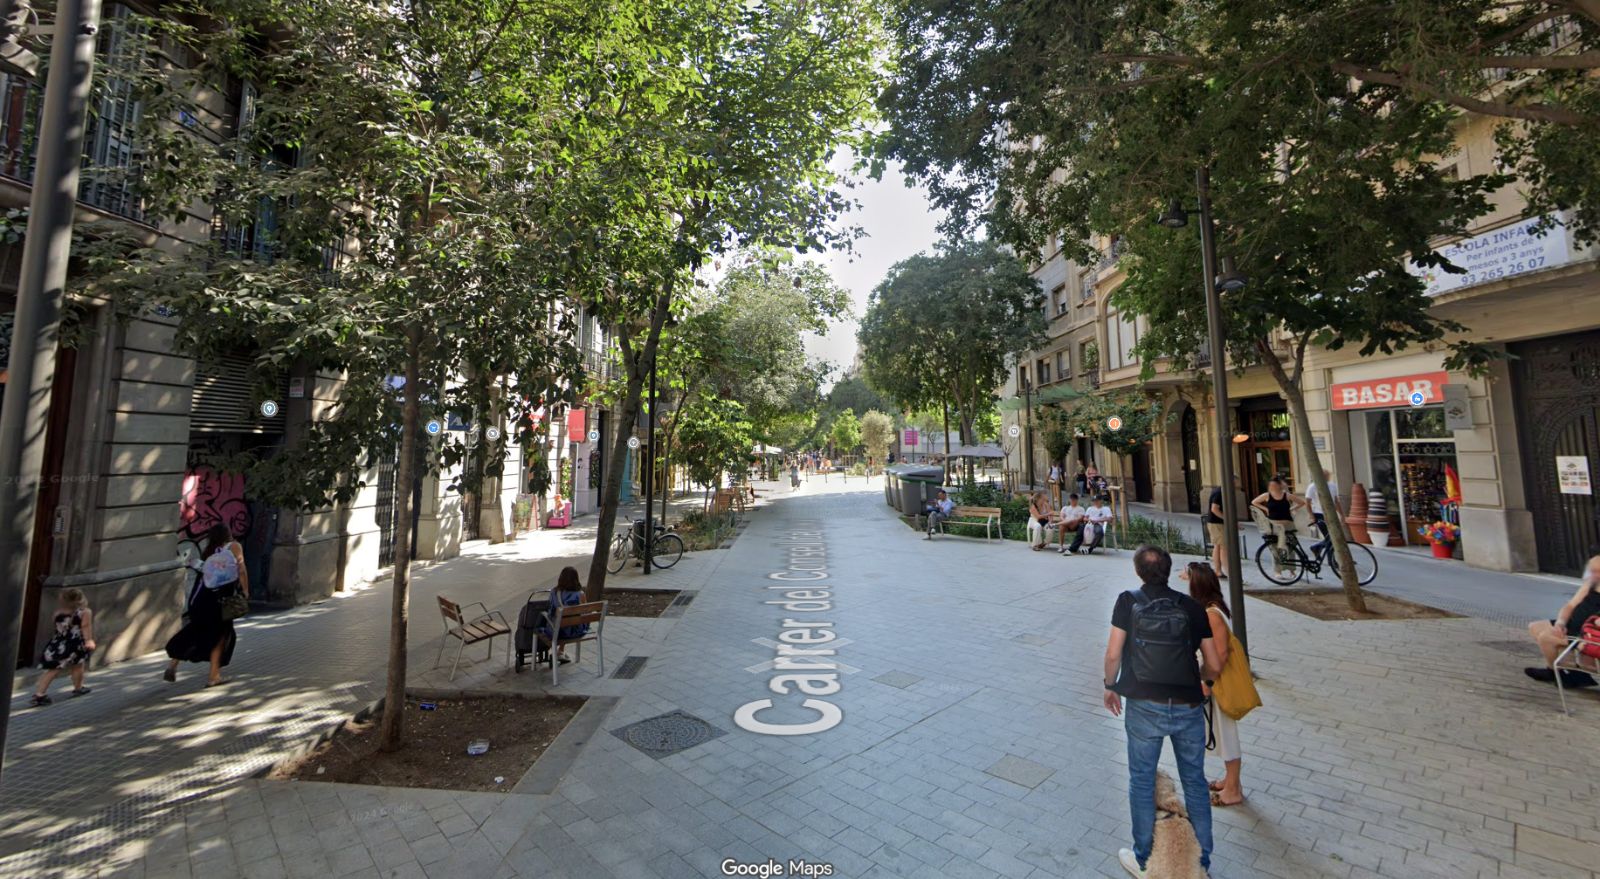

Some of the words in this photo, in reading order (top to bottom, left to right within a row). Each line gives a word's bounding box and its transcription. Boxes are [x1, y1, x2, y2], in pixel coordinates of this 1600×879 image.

[1445, 238, 1489, 257] ESCOLA
[1467, 252, 1481, 261] Per
[1484, 242, 1518, 257] infants
[1521, 237, 1534, 246] de
[1469, 259, 1499, 271] mesos
[1511, 252, 1517, 260] 3
[1520, 245, 1544, 258] anys
[1461, 275, 1476, 285] 93
[1481, 267, 1504, 281] 265
[1509, 262, 1524, 274] 26
[1528, 256, 1545, 268] 07
[1341, 380, 1434, 405] BASAR
